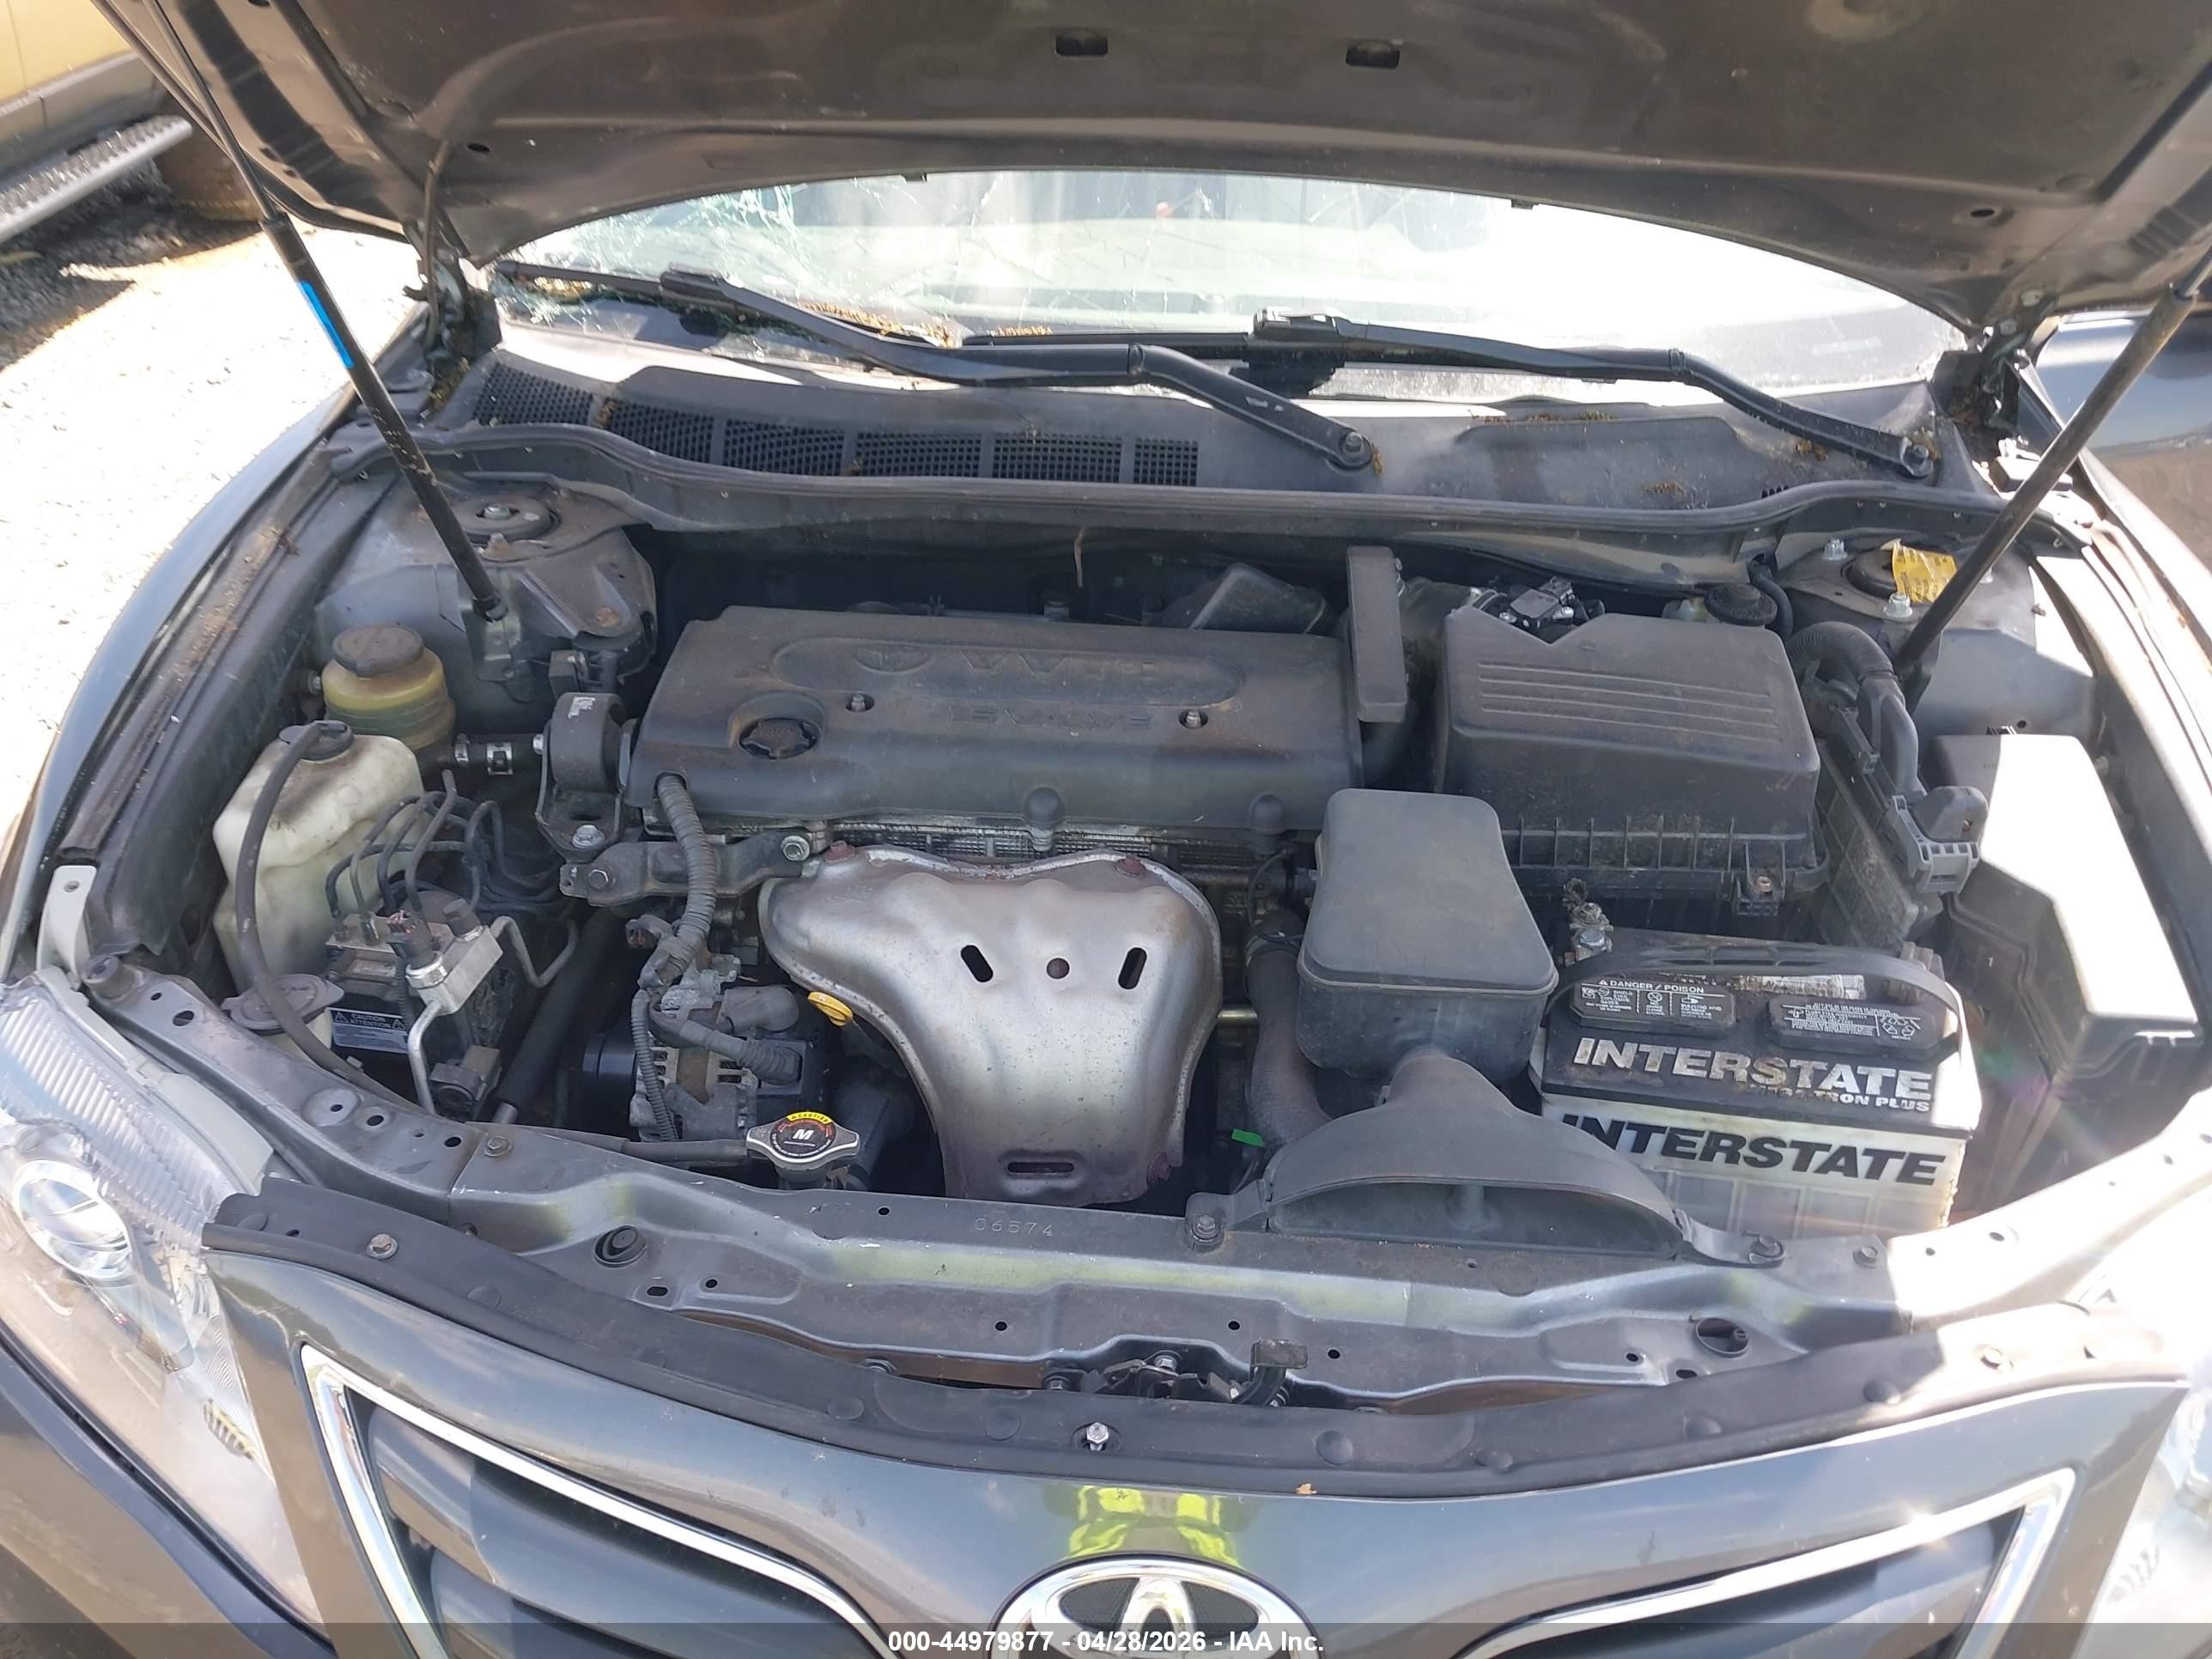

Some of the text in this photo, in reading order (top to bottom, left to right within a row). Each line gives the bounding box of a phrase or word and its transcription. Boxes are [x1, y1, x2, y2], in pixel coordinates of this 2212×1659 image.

[1610, 980, 1653, 990] DANGER
[1664, 984, 1705, 994] POISON
[1573, 1037, 1932, 1102] INTERSTATE
[1875, 1097, 1930, 1112] PLUS
